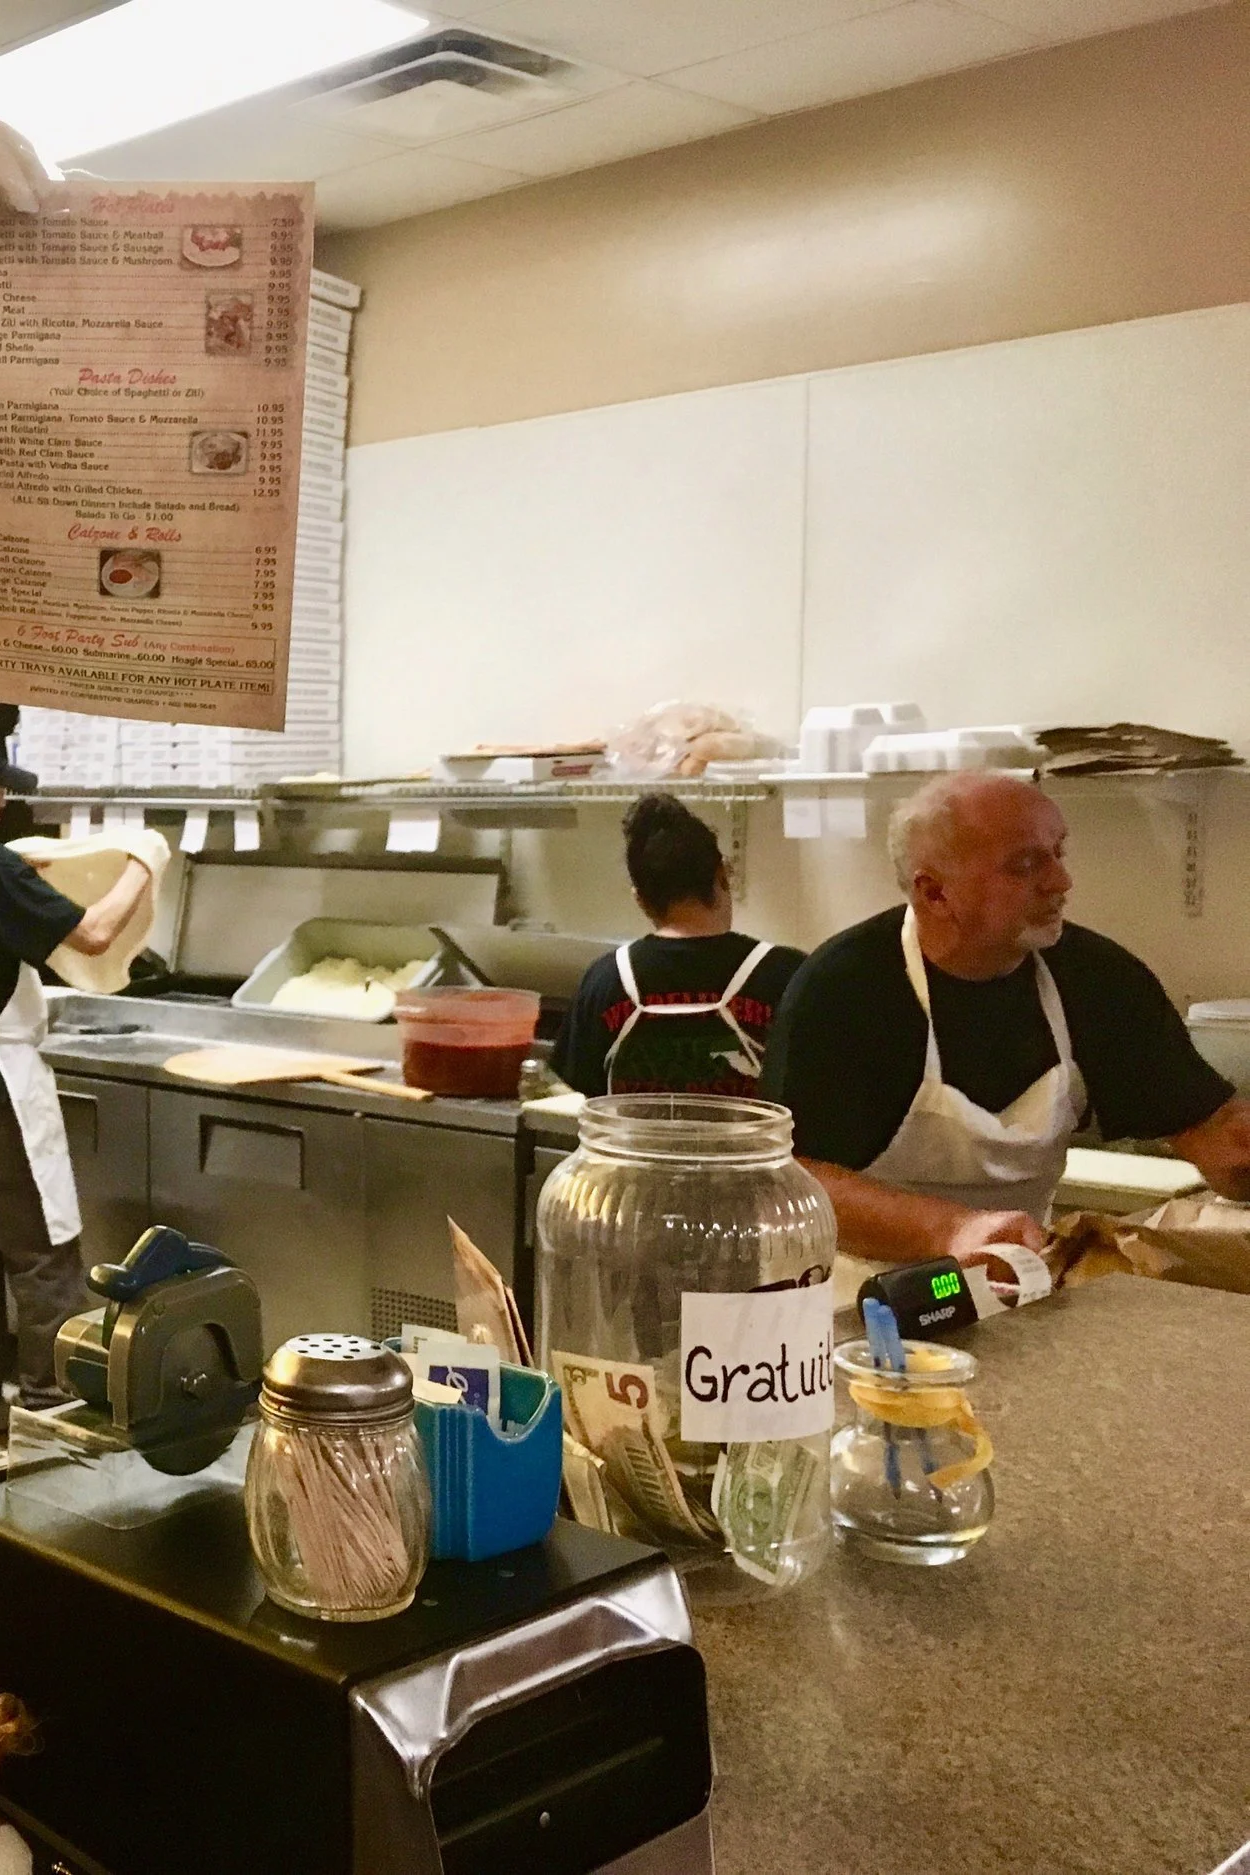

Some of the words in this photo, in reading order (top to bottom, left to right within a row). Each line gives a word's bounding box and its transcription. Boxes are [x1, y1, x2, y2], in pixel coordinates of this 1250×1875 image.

[2, 293, 37, 303] Cheese
[1, 306, 25, 315] Meat
[19, 318, 39, 328] with
[81, 319, 131, 329] Mozzarella
[133, 319, 164, 329] Sauce
[78, 367, 122, 385] Pasta
[127, 367, 177, 385] Dishes
[111, 387, 120, 397] of
[124, 388, 170, 400] Spaghetti
[257, 403, 285, 413] 10.95
[69, 415, 104, 424] Tomato
[106, 415, 135, 424] Sauce
[149, 415, 198, 425] Mozzarella
[256, 416, 284, 426] 10.95
[75, 439, 103, 448] Sauce
[260, 441, 283, 450] 9.95
[66, 450, 95, 459] Sauce
[80, 461, 109, 471] Sauce
[258, 477, 281, 487] 9.95
[106, 486, 144, 497] Chicken
[146, 526, 183, 543] Rolls
[30, 625, 61, 642] Foot
[66, 629, 106, 648] Party
[111, 633, 142, 649] Sub
[13, 638, 45, 651] Cheese
[82, 647, 130, 660] Submarine
[171, 655, 204, 667] Hoagie
[205, 657, 240, 671] Special
[21, 660, 56, 675] TRAYS
[58, 665, 120, 682] AVAILABLE
[122, 673, 145, 686] FOR
[147, 675, 171, 687] ANY
[174, 677, 197, 689] HOT
[200, 679, 236, 692] PLATE
[918, 1305, 957, 1327] SHARP
[685, 1331, 834, 1404] Gratuit
